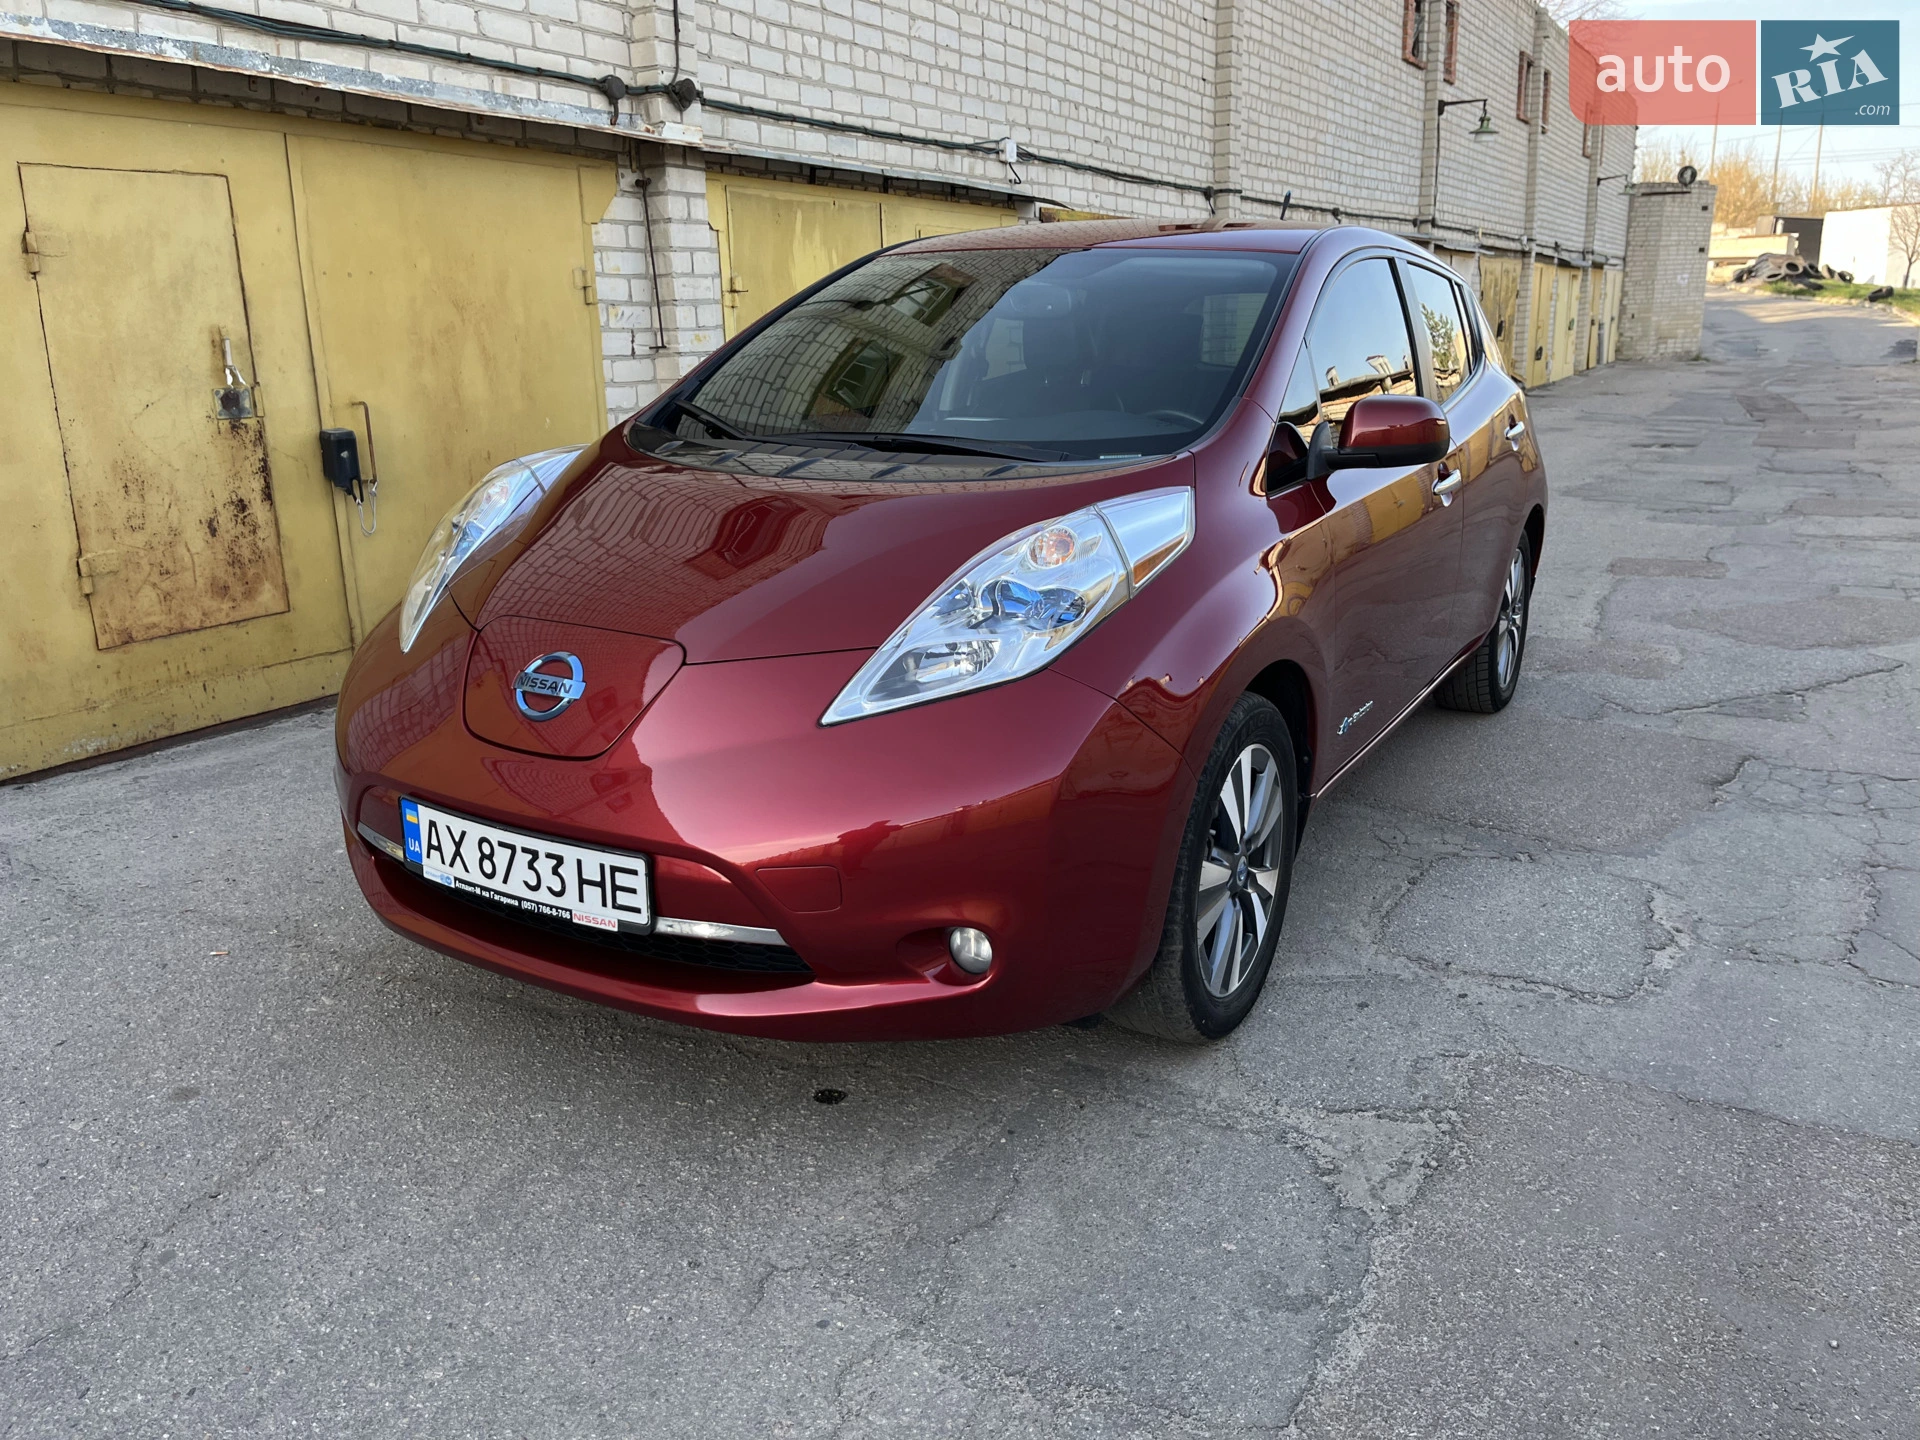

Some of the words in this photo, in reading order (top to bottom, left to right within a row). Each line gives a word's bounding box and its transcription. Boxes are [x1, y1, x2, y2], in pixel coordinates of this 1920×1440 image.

[518, 676, 573, 693] NISSAN
[408, 837, 421, 853] UA
[426, 818, 470, 874] AX
[477, 836, 567, 898] 8733
[576, 857, 642, 915] HE
[521, 899, 538, 913] (057)
[538, 904, 571, 920] 766-8-766
[573, 912, 617, 929] NISSAN
